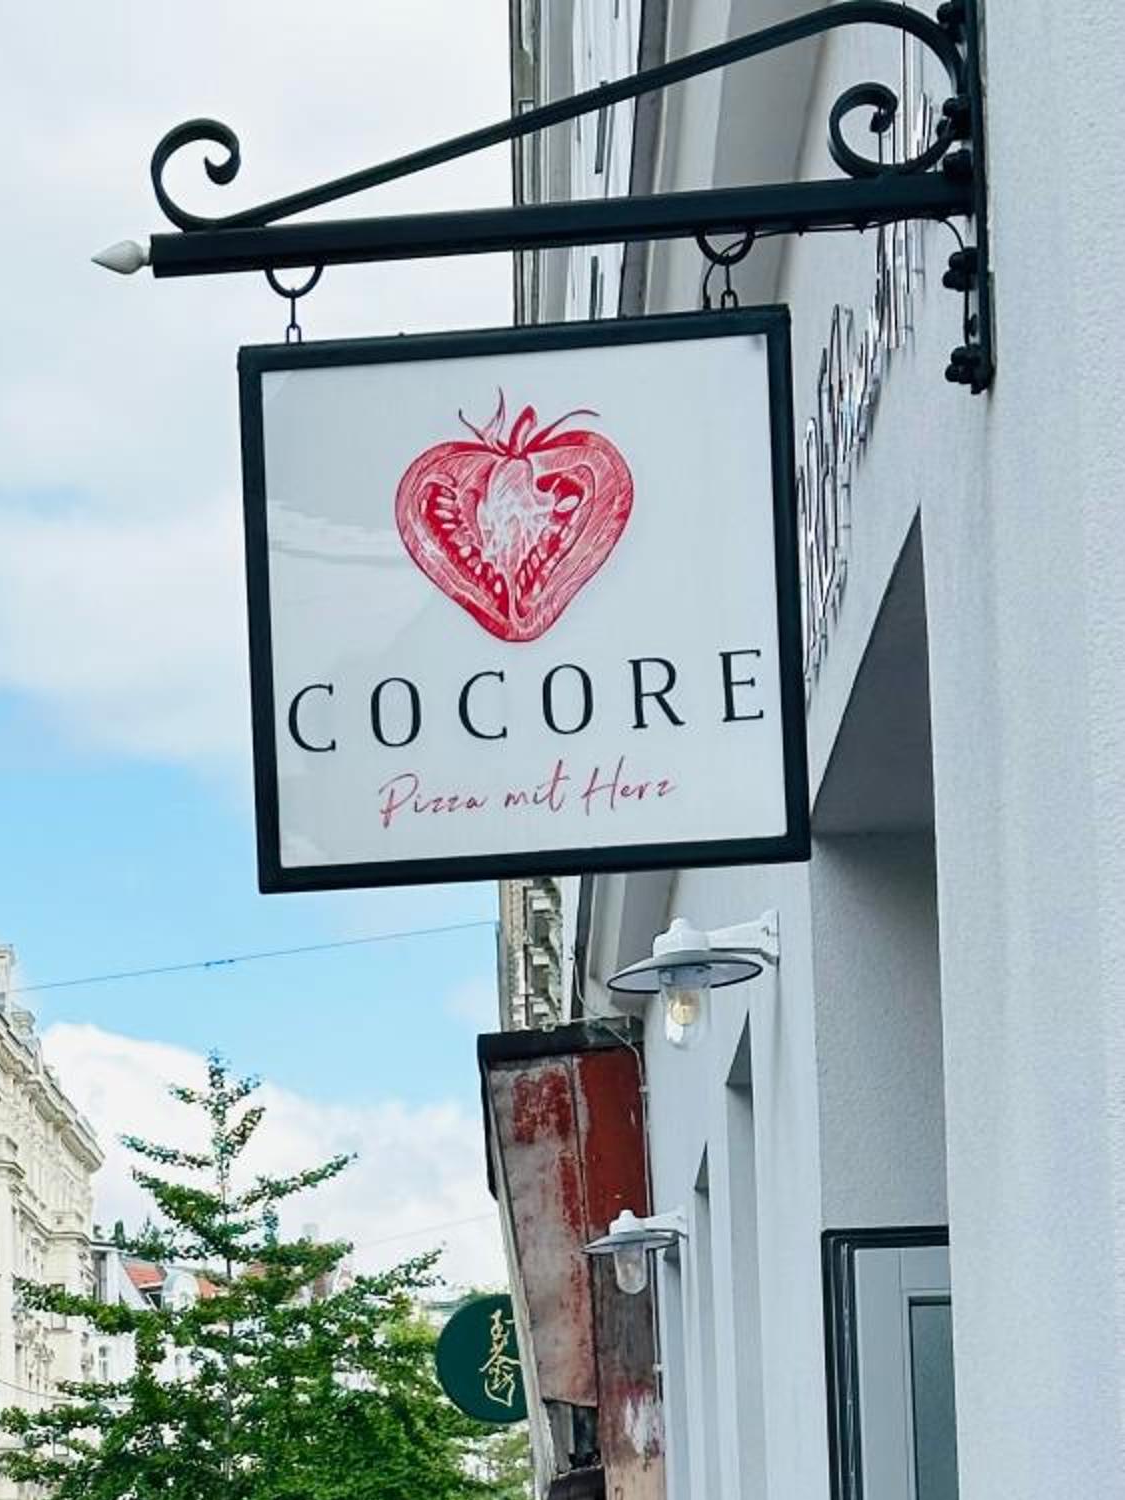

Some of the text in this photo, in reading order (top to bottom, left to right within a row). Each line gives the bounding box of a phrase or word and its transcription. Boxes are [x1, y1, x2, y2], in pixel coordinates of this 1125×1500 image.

[287, 648, 765, 753] COCORE
[378, 755, 676, 829] Pizza mit Herz
